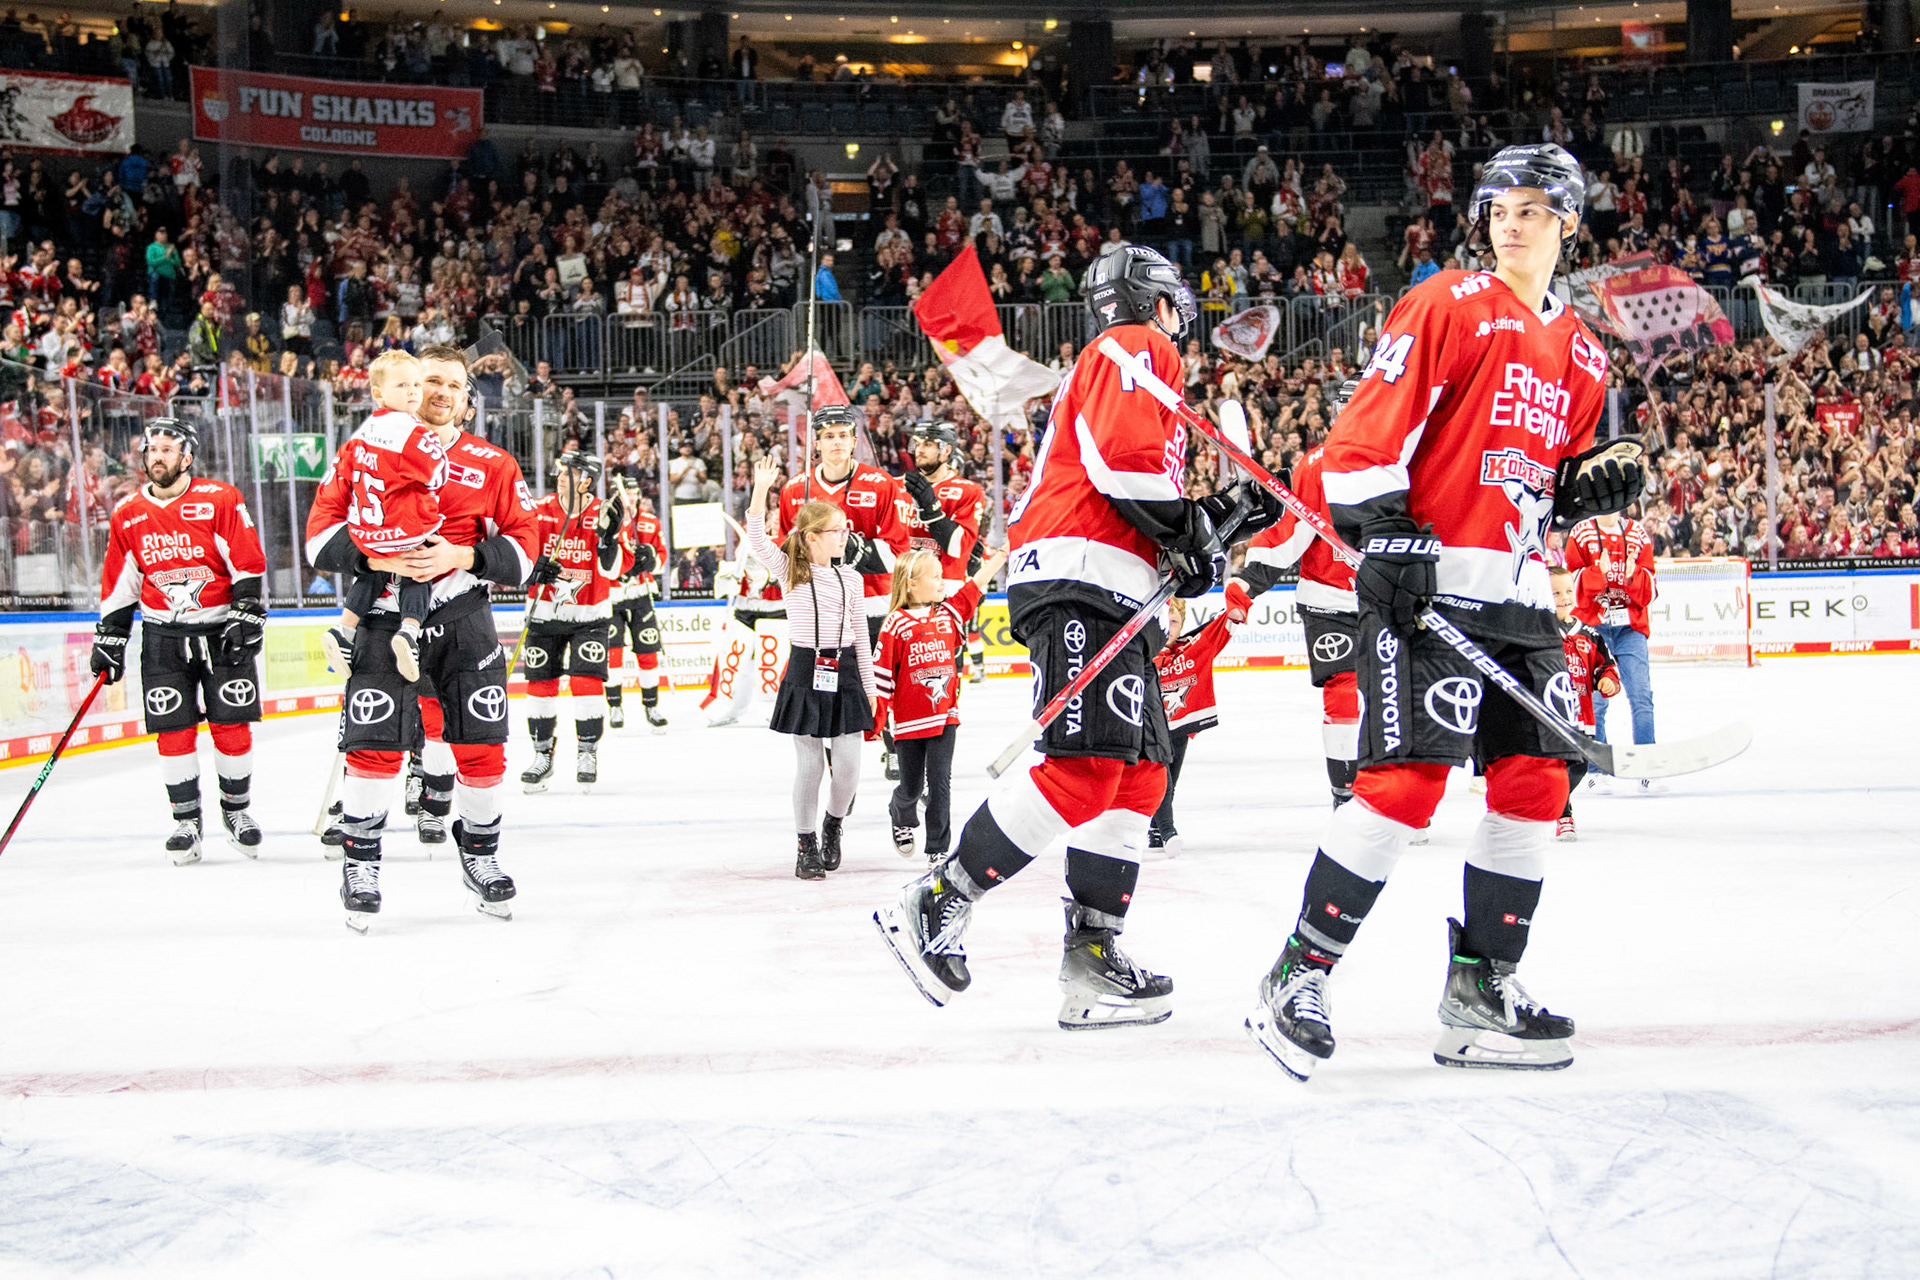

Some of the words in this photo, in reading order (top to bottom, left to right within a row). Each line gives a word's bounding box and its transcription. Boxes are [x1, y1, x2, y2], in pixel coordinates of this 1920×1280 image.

[239, 86, 302, 119] FUN
[312, 94, 436, 127] SHARKS
[300, 126, 377, 146] COLOGNE
[1504, 362, 1571, 416] Rhein
[142, 530, 191, 549] Rhein
[227, 610, 266, 627] AUER
[659, 613, 711, 632] xis.de
[93, 634, 127, 646] AUER
[978, 616, 1012, 646] Kö
[910, 638, 946, 654] Rhein
[1420, 610, 1520, 691] BAUER
[478, 643, 503, 671] BAU
[659, 654, 712, 668] eitsrecht
[758, 634, 779, 695] pape
[1213, 656, 1249, 667] ENNY.
[1283, 655, 1310, 666] PEN
[720, 639, 746, 700] pape
[1159, 659, 1195, 676] ergie
[1065, 655, 1084, 736] TOOTA
[1381, 662, 1401, 752] TOYOTA
